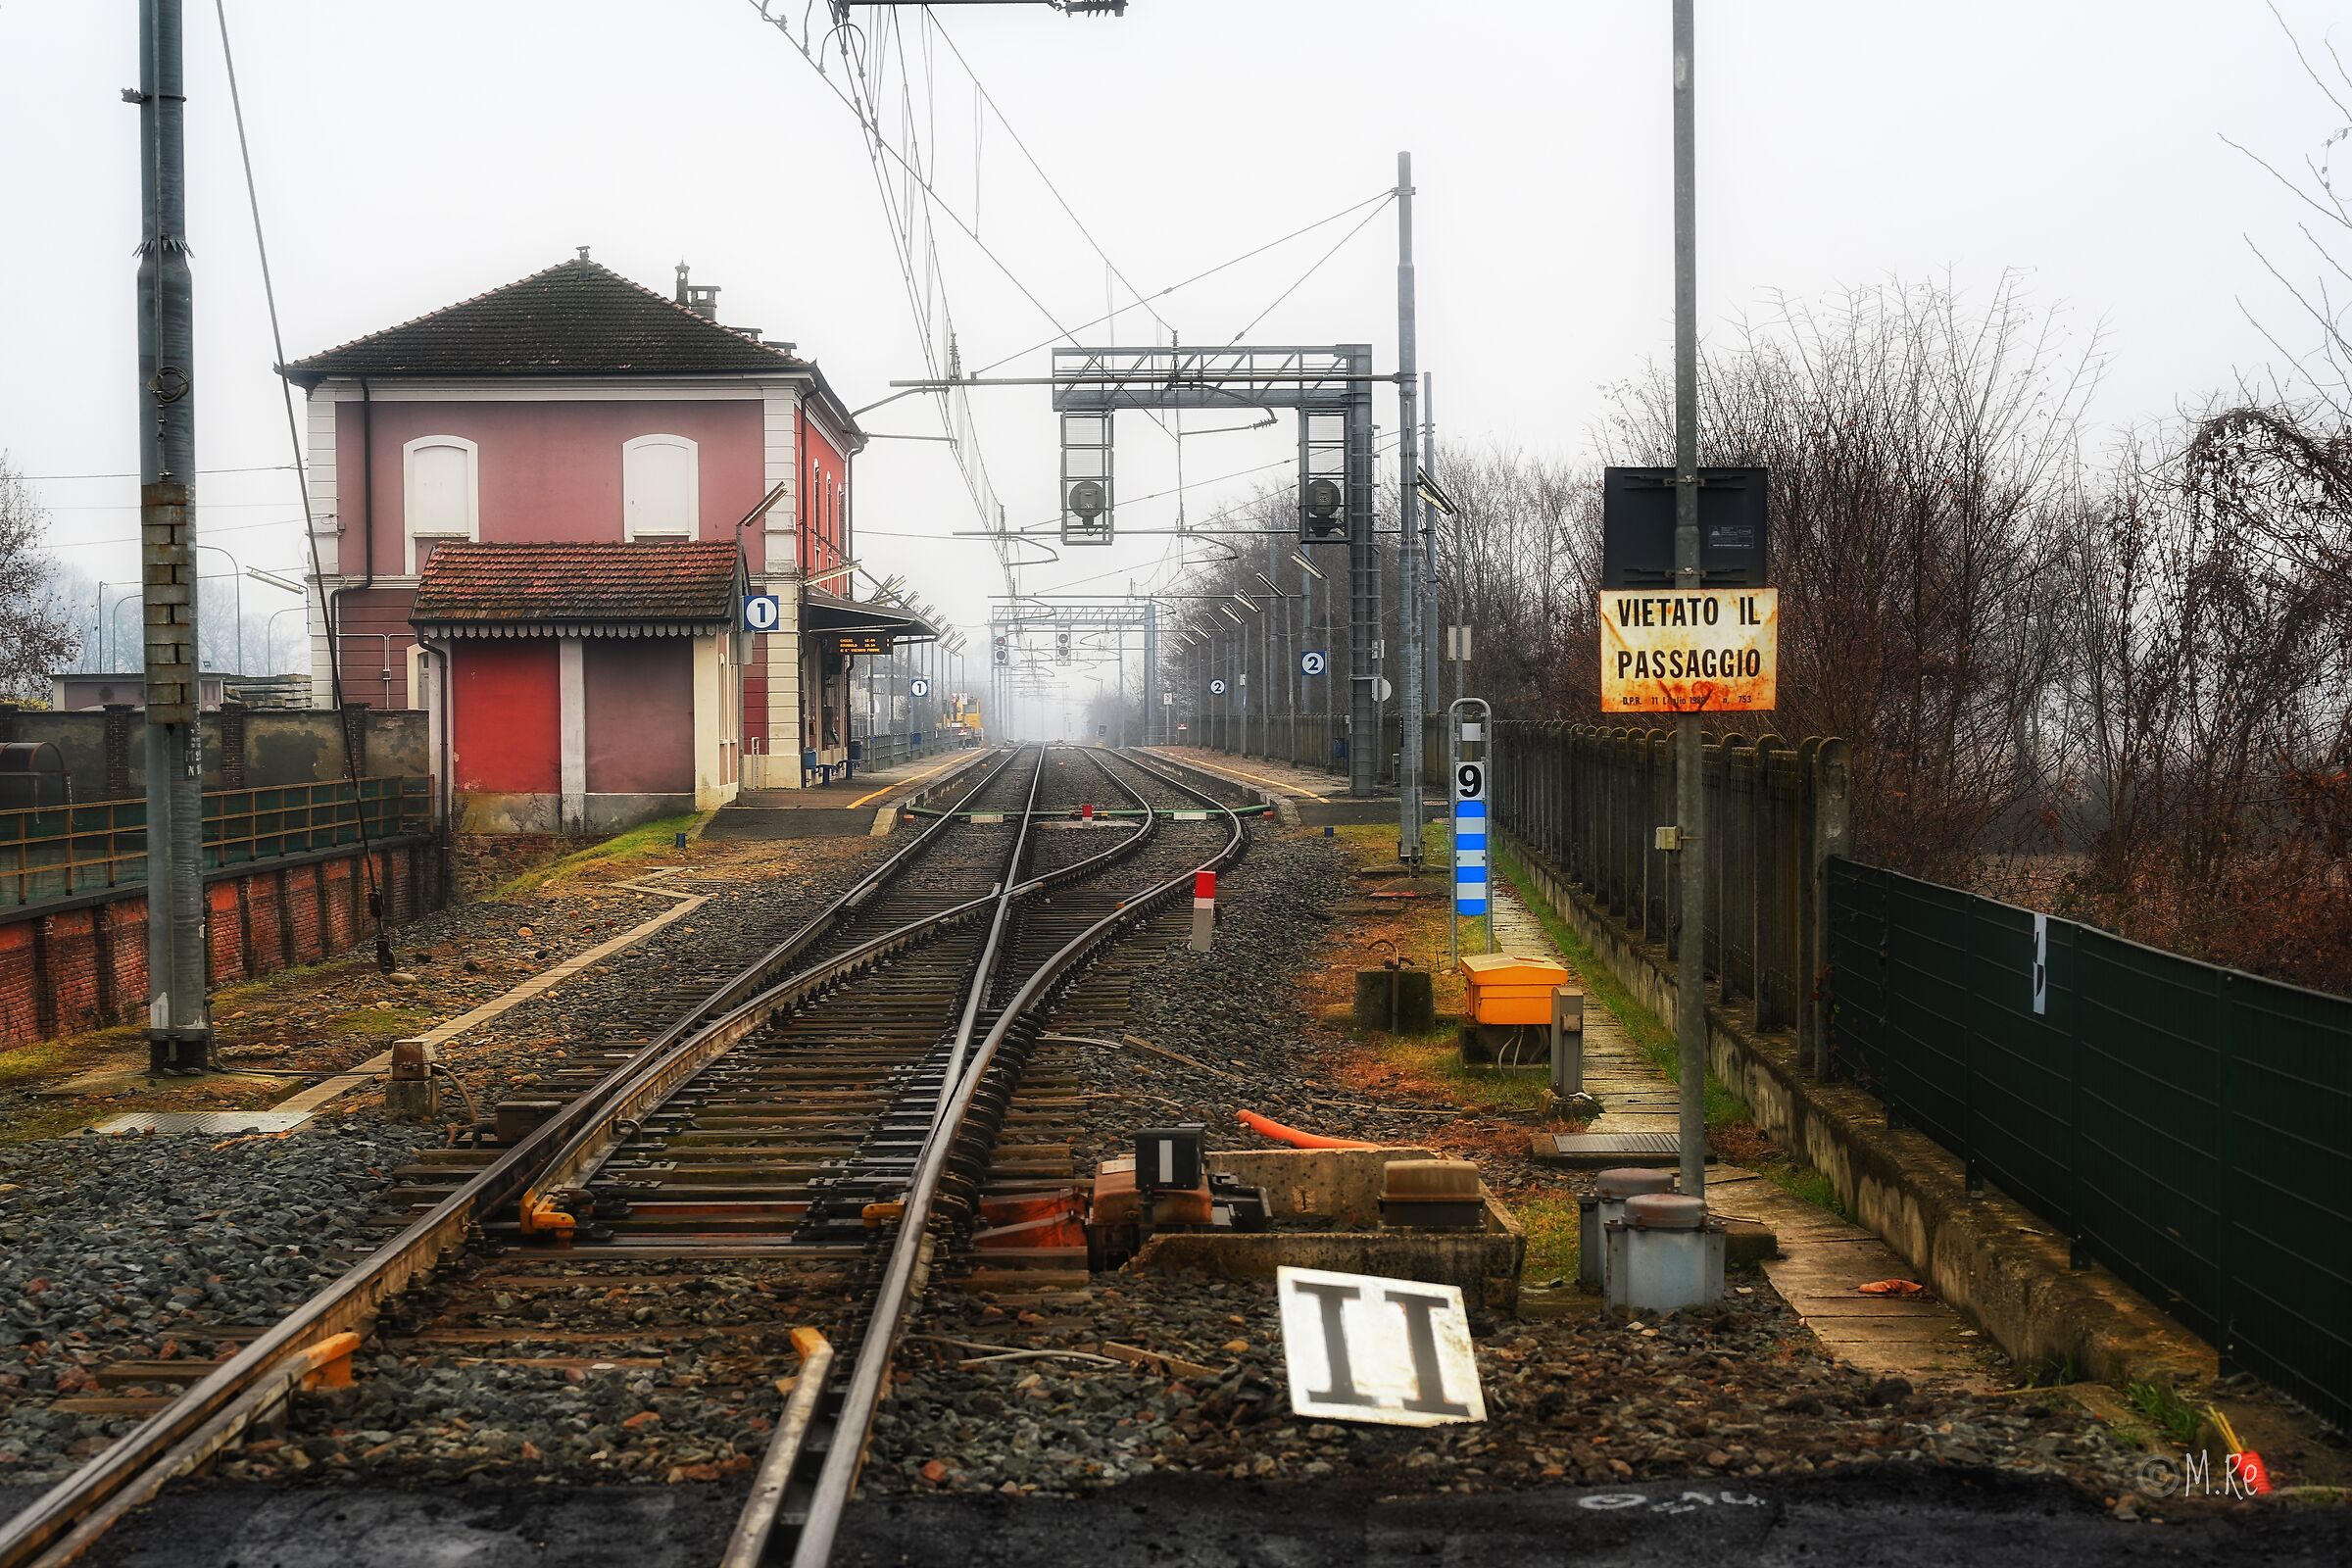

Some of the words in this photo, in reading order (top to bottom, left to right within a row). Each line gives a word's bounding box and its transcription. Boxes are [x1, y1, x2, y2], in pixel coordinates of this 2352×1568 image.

[757, 603, 766, 623] 1
[1617, 597, 1719, 627] VIETATO
[1740, 596, 1761, 625] IL
[1307, 656, 1319, 671] 2
[1617, 648, 1761, 679] PASSAGGIO
[1651, 696, 1658, 705] 11
[1458, 764, 1483, 798] 9
